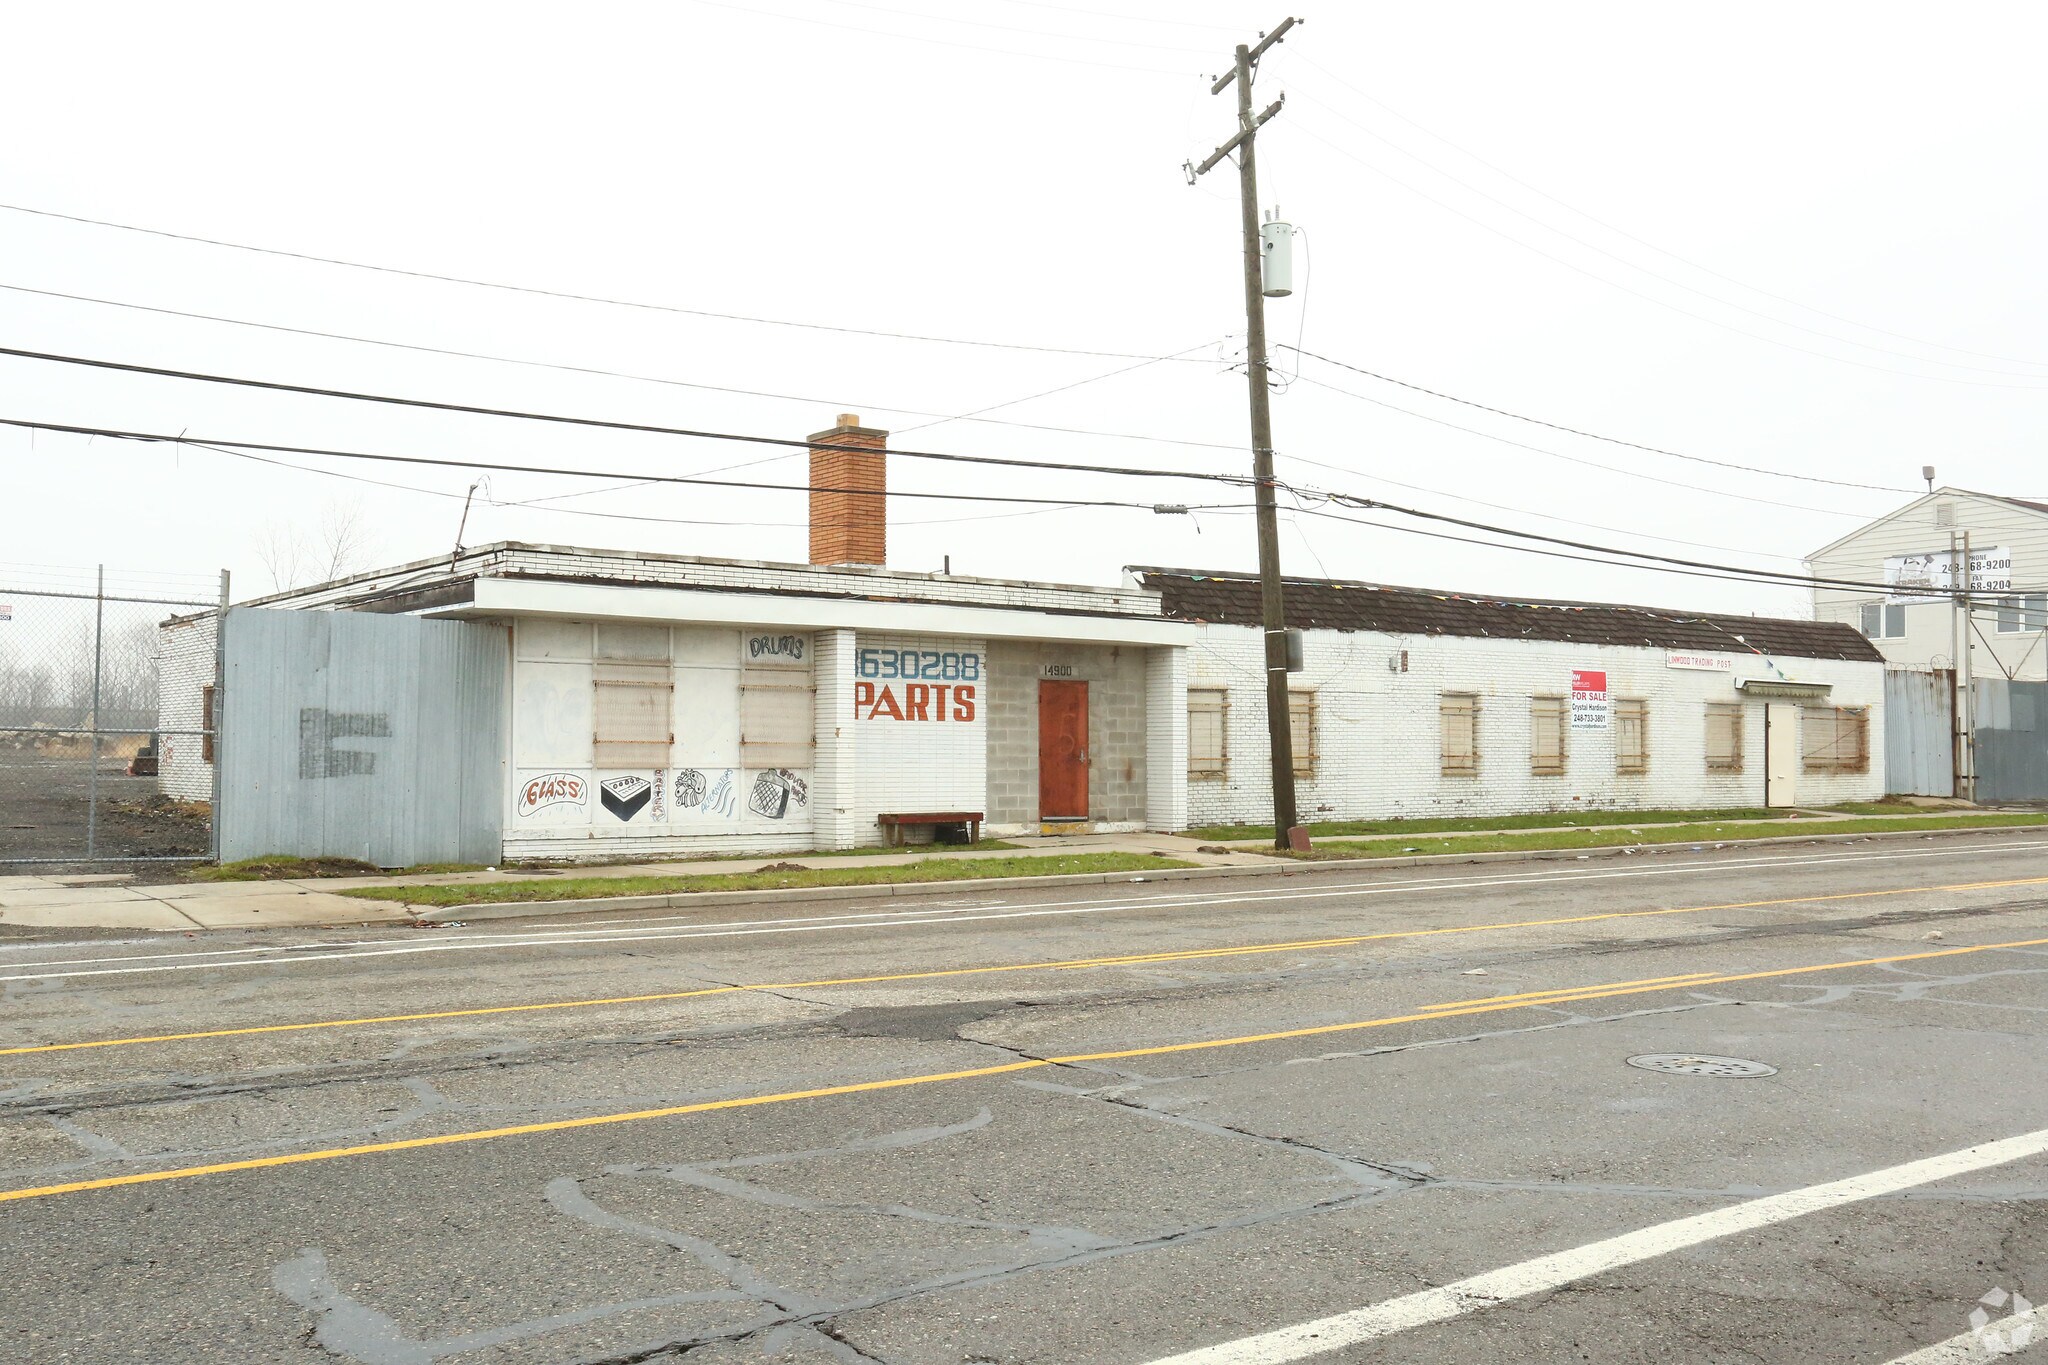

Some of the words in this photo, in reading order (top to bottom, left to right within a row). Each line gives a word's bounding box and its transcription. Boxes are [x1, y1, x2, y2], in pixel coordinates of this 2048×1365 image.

[1942, 559, 2011, 573] 248-68-9200
[749, 635, 804, 660] DRUMS
[855, 649, 980, 681] 630288
[1691, 657, 1713, 666] TRADING
[1717, 659, 1731, 668] POST
[1044, 665, 1072, 676] 14900
[855, 681, 976, 722] PARTS
[1572, 691, 1587, 701] FOR
[1589, 692, 1607, 702] SALE
[1572, 703, 1588, 712] Crystal
[526, 780, 579, 805] GLASS
